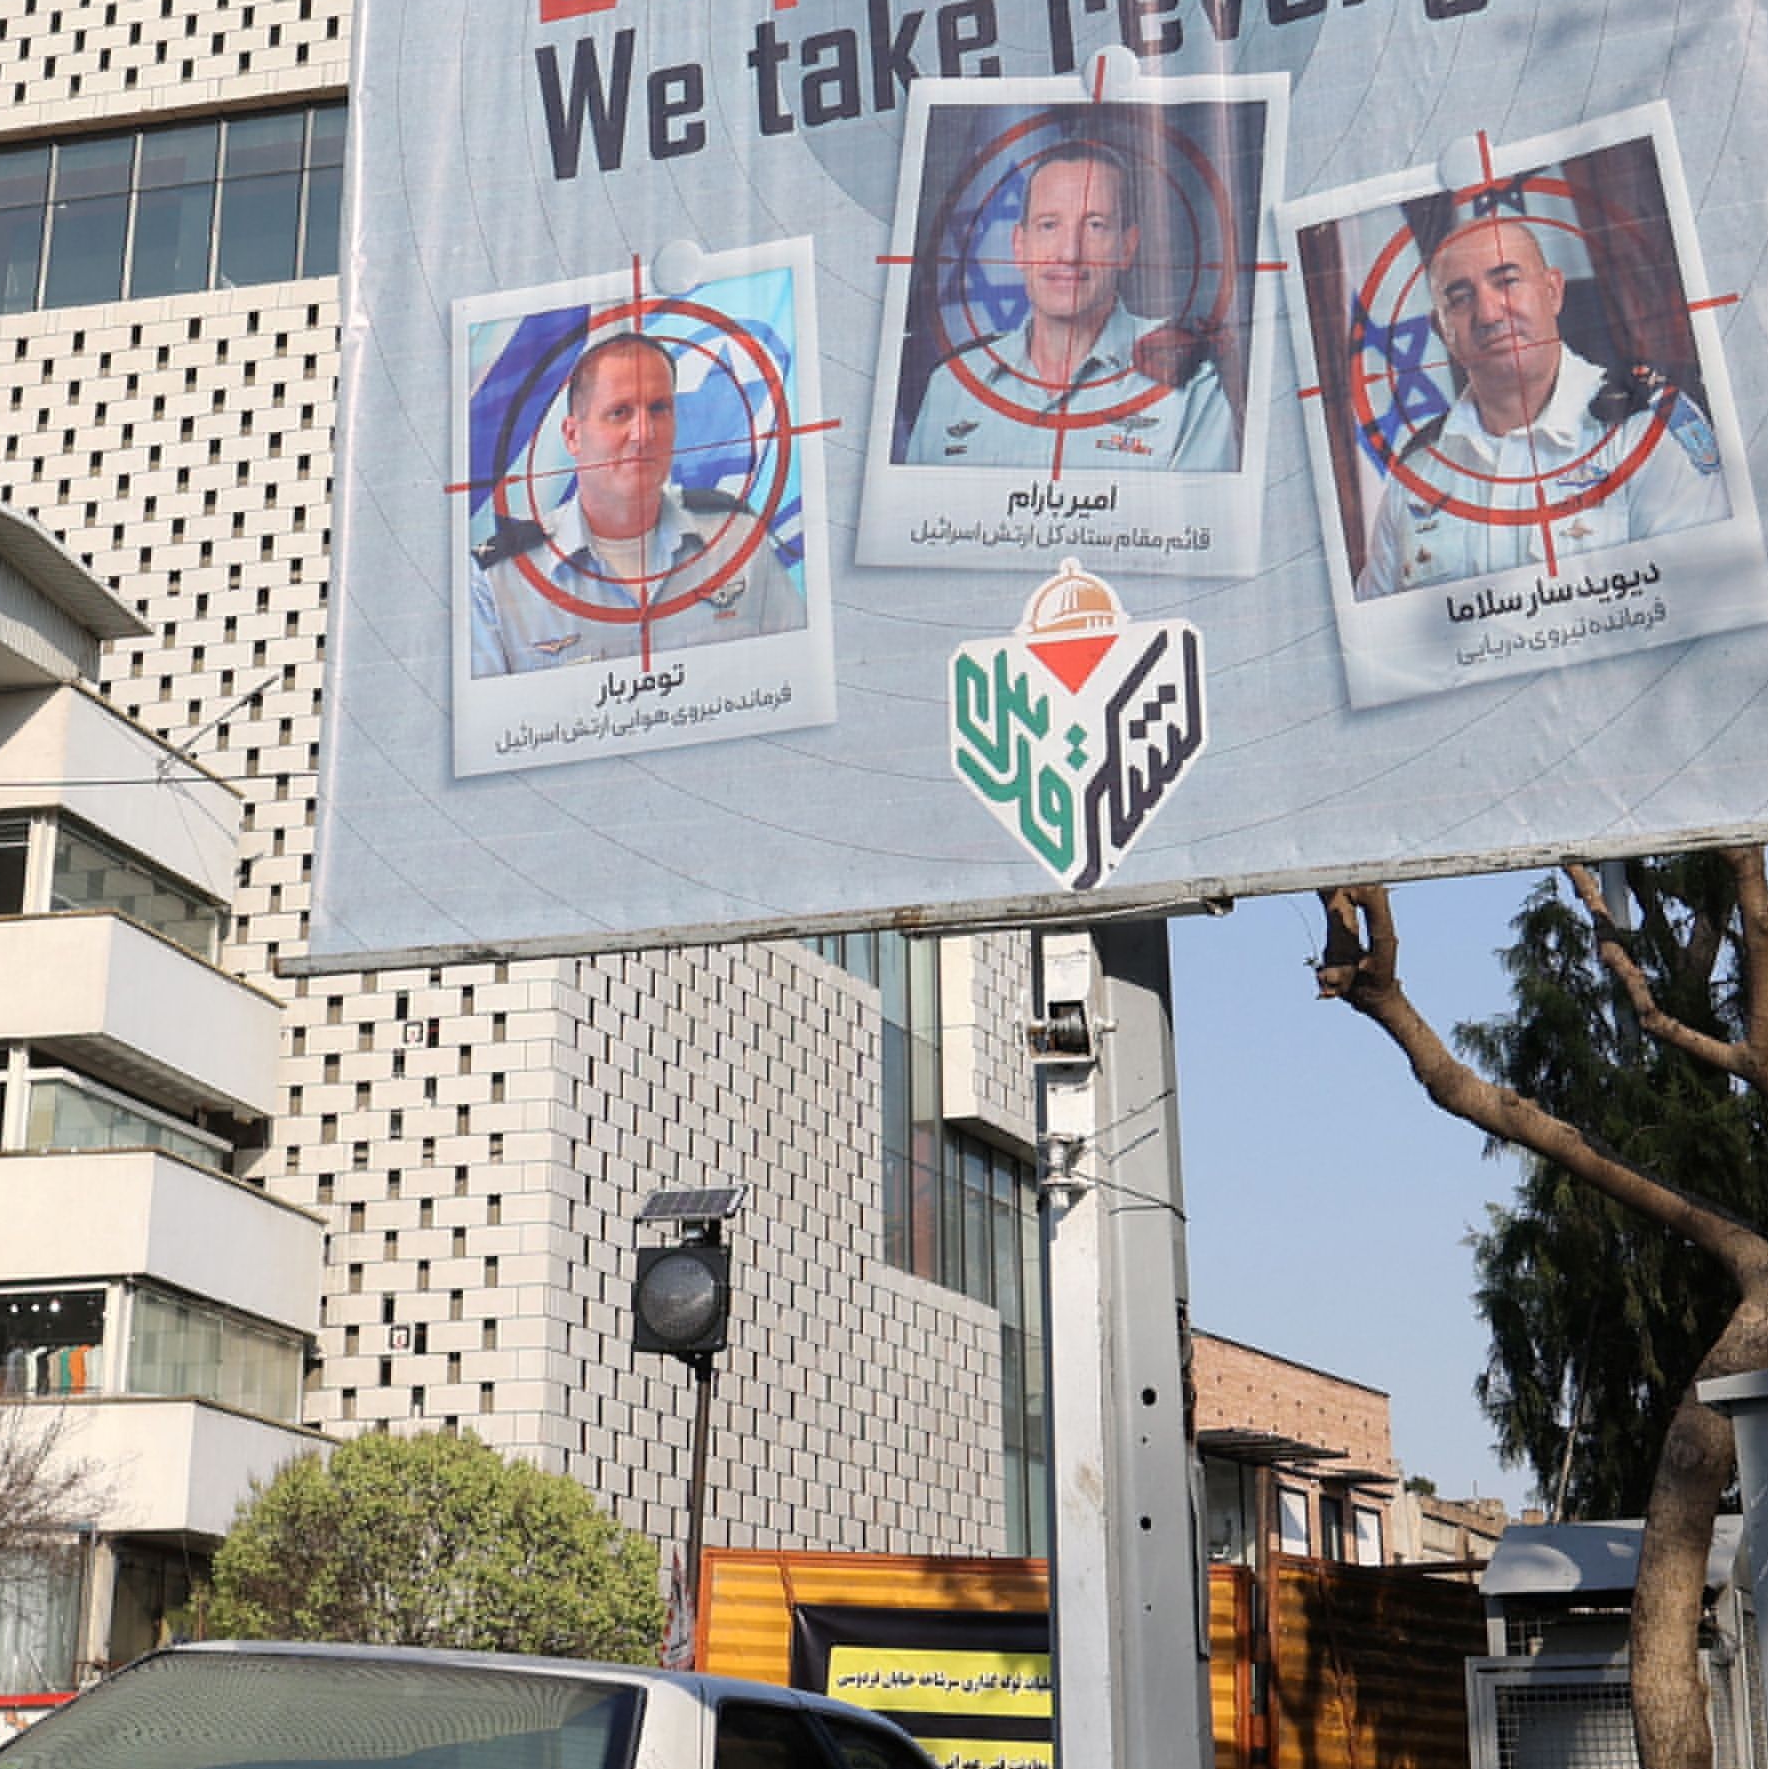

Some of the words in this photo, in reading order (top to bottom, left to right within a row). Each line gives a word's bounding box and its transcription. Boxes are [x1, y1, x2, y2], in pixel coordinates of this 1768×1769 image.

[533, 28, 708, 183] We
[1007, 480, 1065, 518] بارام
[1065, 484, 1119, 520] امیر
[910, 516, 982, 547] اسرائیل
[983, 520, 1035, 549] ارتش
[1037, 521, 1068, 549] کل
[1071, 525, 1118, 548] ستاد
[1119, 527, 1162, 553] مقام
[1577, 561, 1661, 603] دیوید
[1446, 589, 1524, 624] سلاما
[1527, 579, 1575, 619] سار
[1588, 596, 1667, 635] فرمانده
[1454, 634, 1527, 666] دریایی
[1528, 622, 1588, 652] نیروی
[594, 672, 633, 709] بار
[630, 663, 687, 702] تومر
[725, 682, 793, 714] فرمانده
[613, 709, 669, 738] هوایی
[671, 698, 725, 730] نیروی
[494, 720, 560, 755] اسرائیل
[561, 716, 611, 745] ارتش
